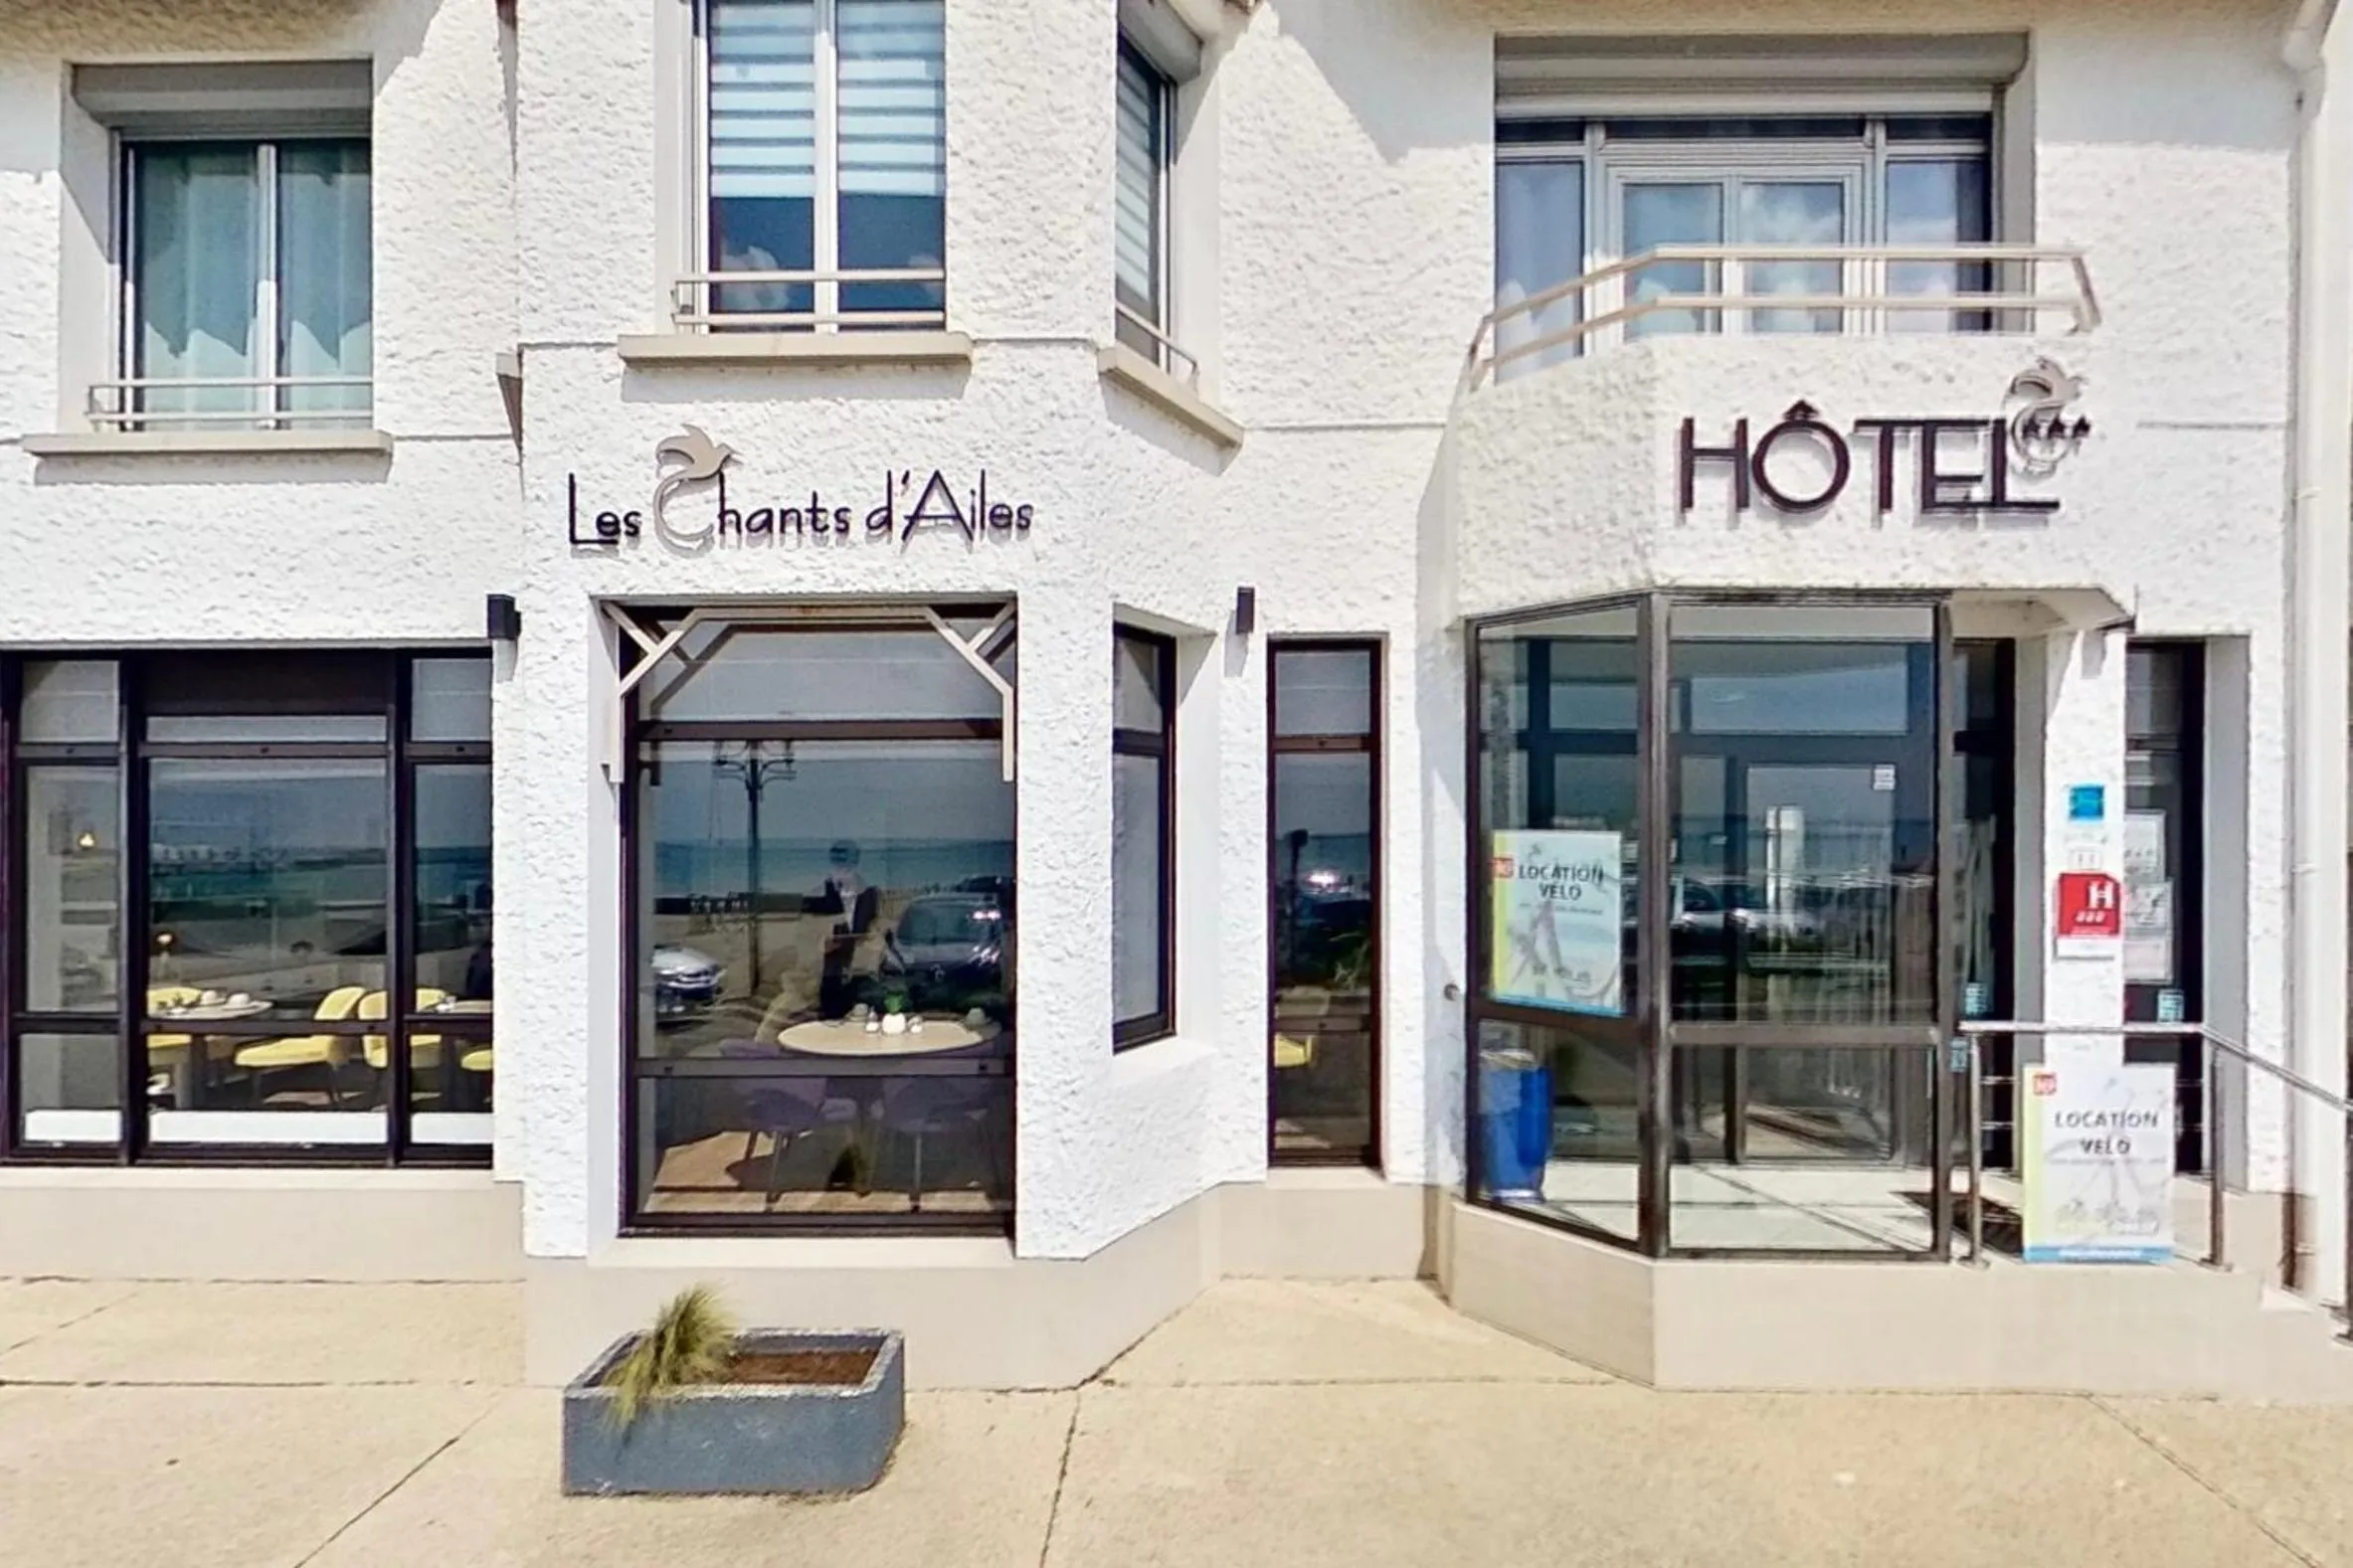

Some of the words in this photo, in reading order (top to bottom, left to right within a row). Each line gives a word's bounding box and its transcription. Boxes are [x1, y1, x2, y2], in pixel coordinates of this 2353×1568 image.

[1679, 399, 2060, 513] HÔTEL
[568, 471, 642, 545] Les
[652, 453, 851, 547] Chants
[865, 468, 1034, 544] d'Ailes
[1519, 864, 1604, 884] LOCATION
[2086, 880, 2115, 910] H
[2055, 1110, 2158, 1129] LOCATION
